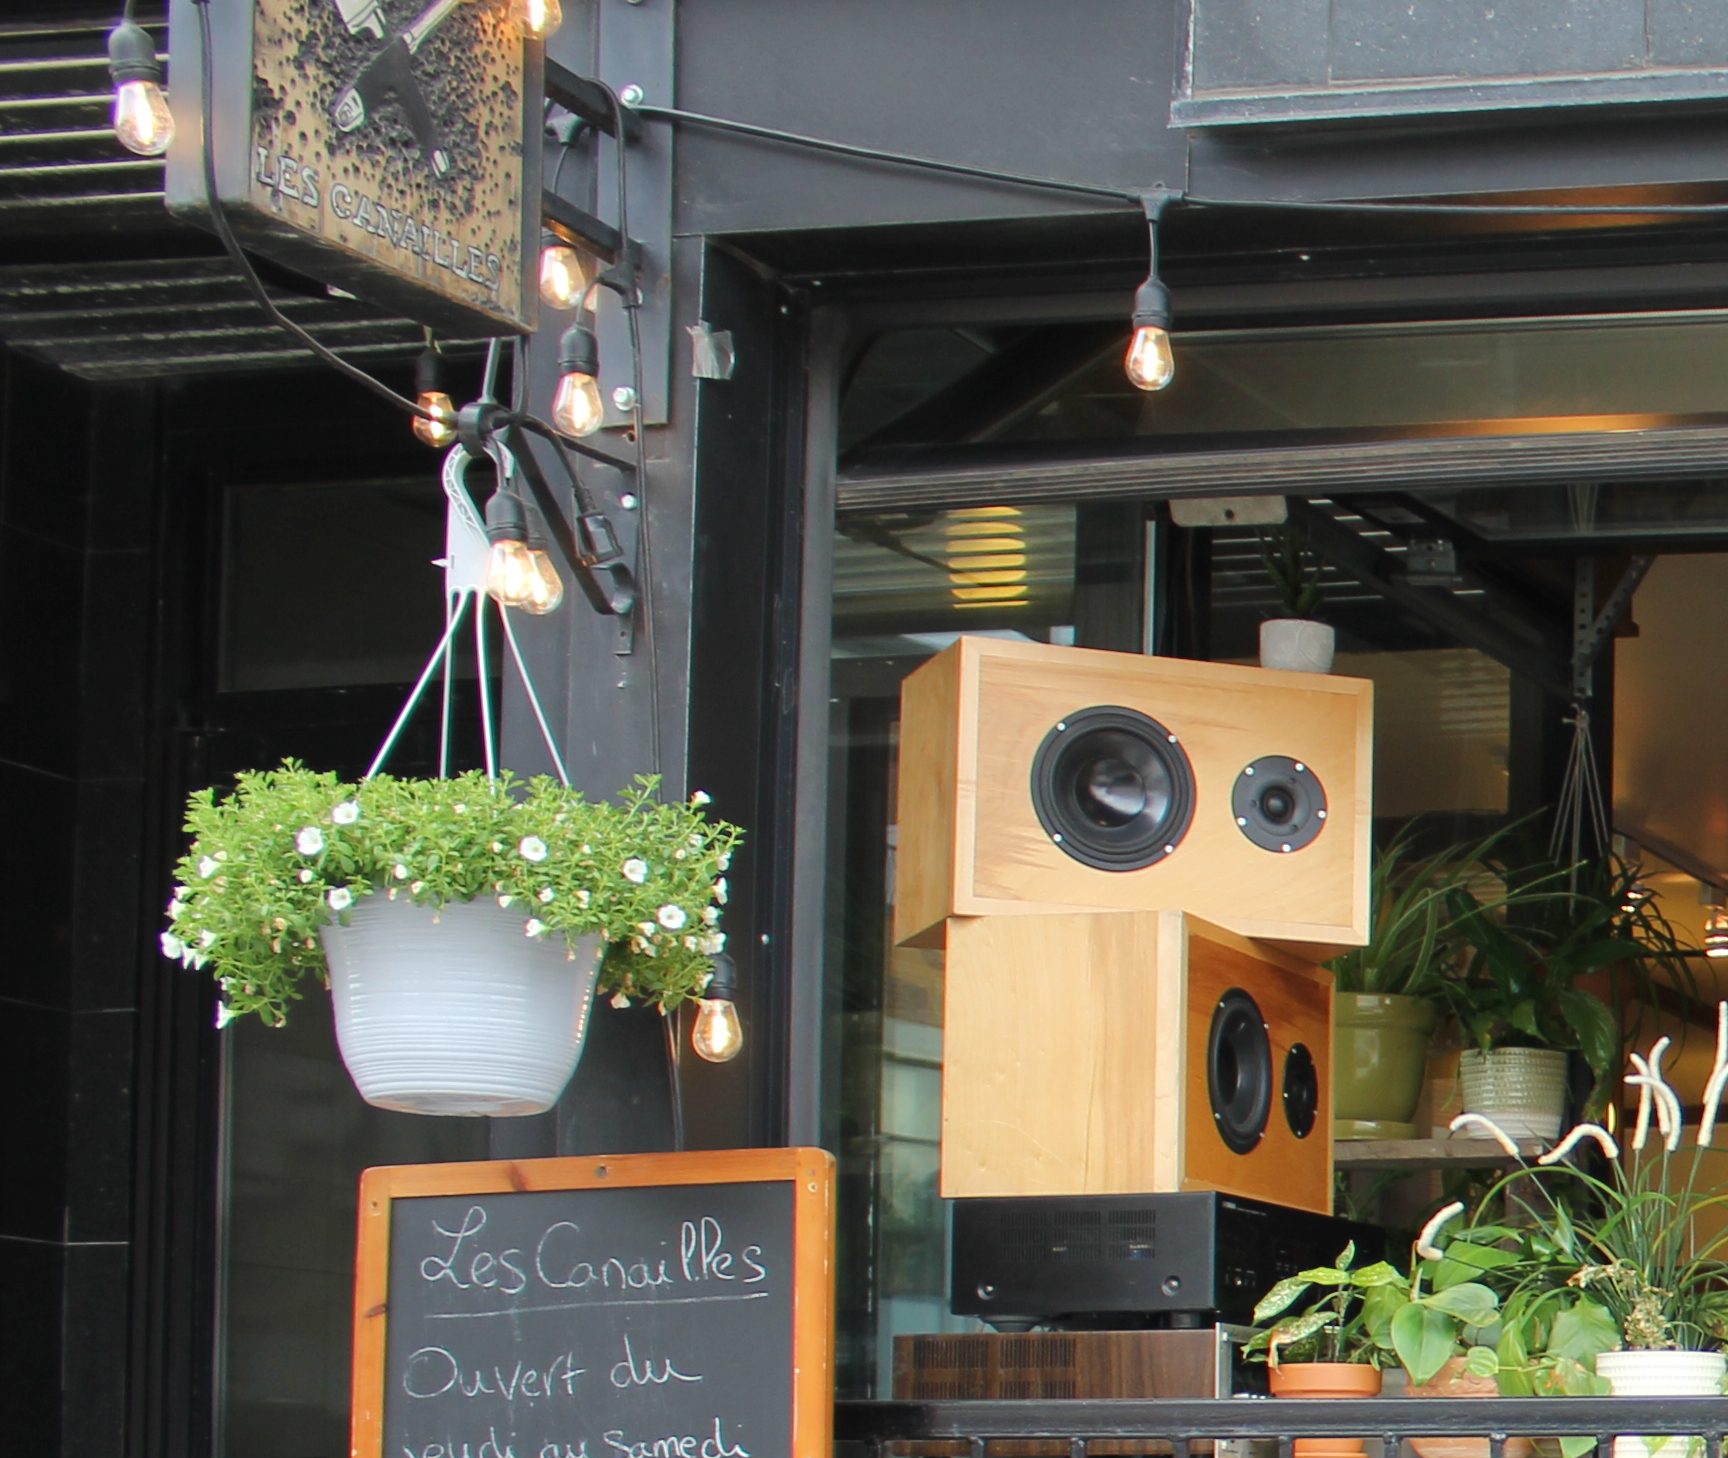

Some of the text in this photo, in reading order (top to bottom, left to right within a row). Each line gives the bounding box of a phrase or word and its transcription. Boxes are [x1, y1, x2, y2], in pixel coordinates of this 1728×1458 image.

[256, 146, 503, 291] LES CANAILLES
[421, 1206, 768, 1293] Les Canailles
[403, 1333, 703, 1401] Ouvert du
